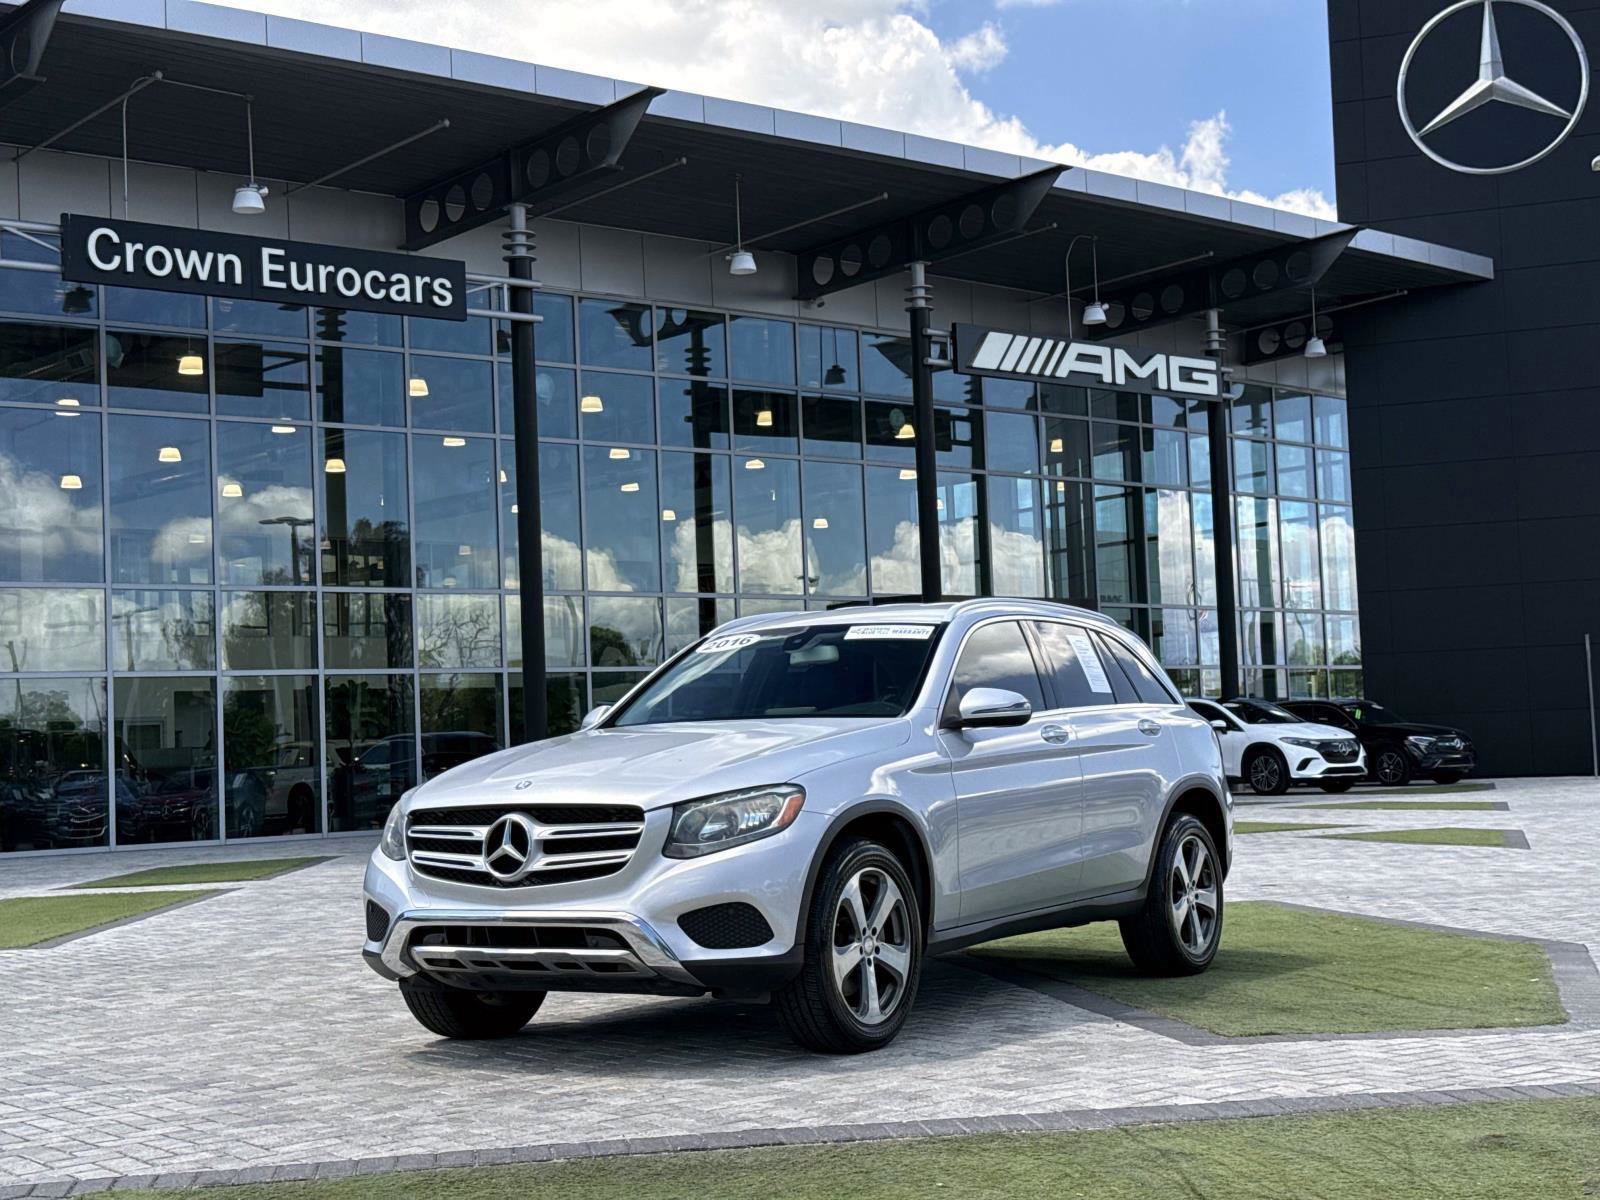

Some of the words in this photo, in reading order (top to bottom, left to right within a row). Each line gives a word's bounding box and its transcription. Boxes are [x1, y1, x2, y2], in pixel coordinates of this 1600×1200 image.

[86, 227, 243, 285] Crown
[260, 246, 454, 308] Eurocars
[1055, 341, 1219, 396] AMG
[702, 636, 755, 651] 2016
